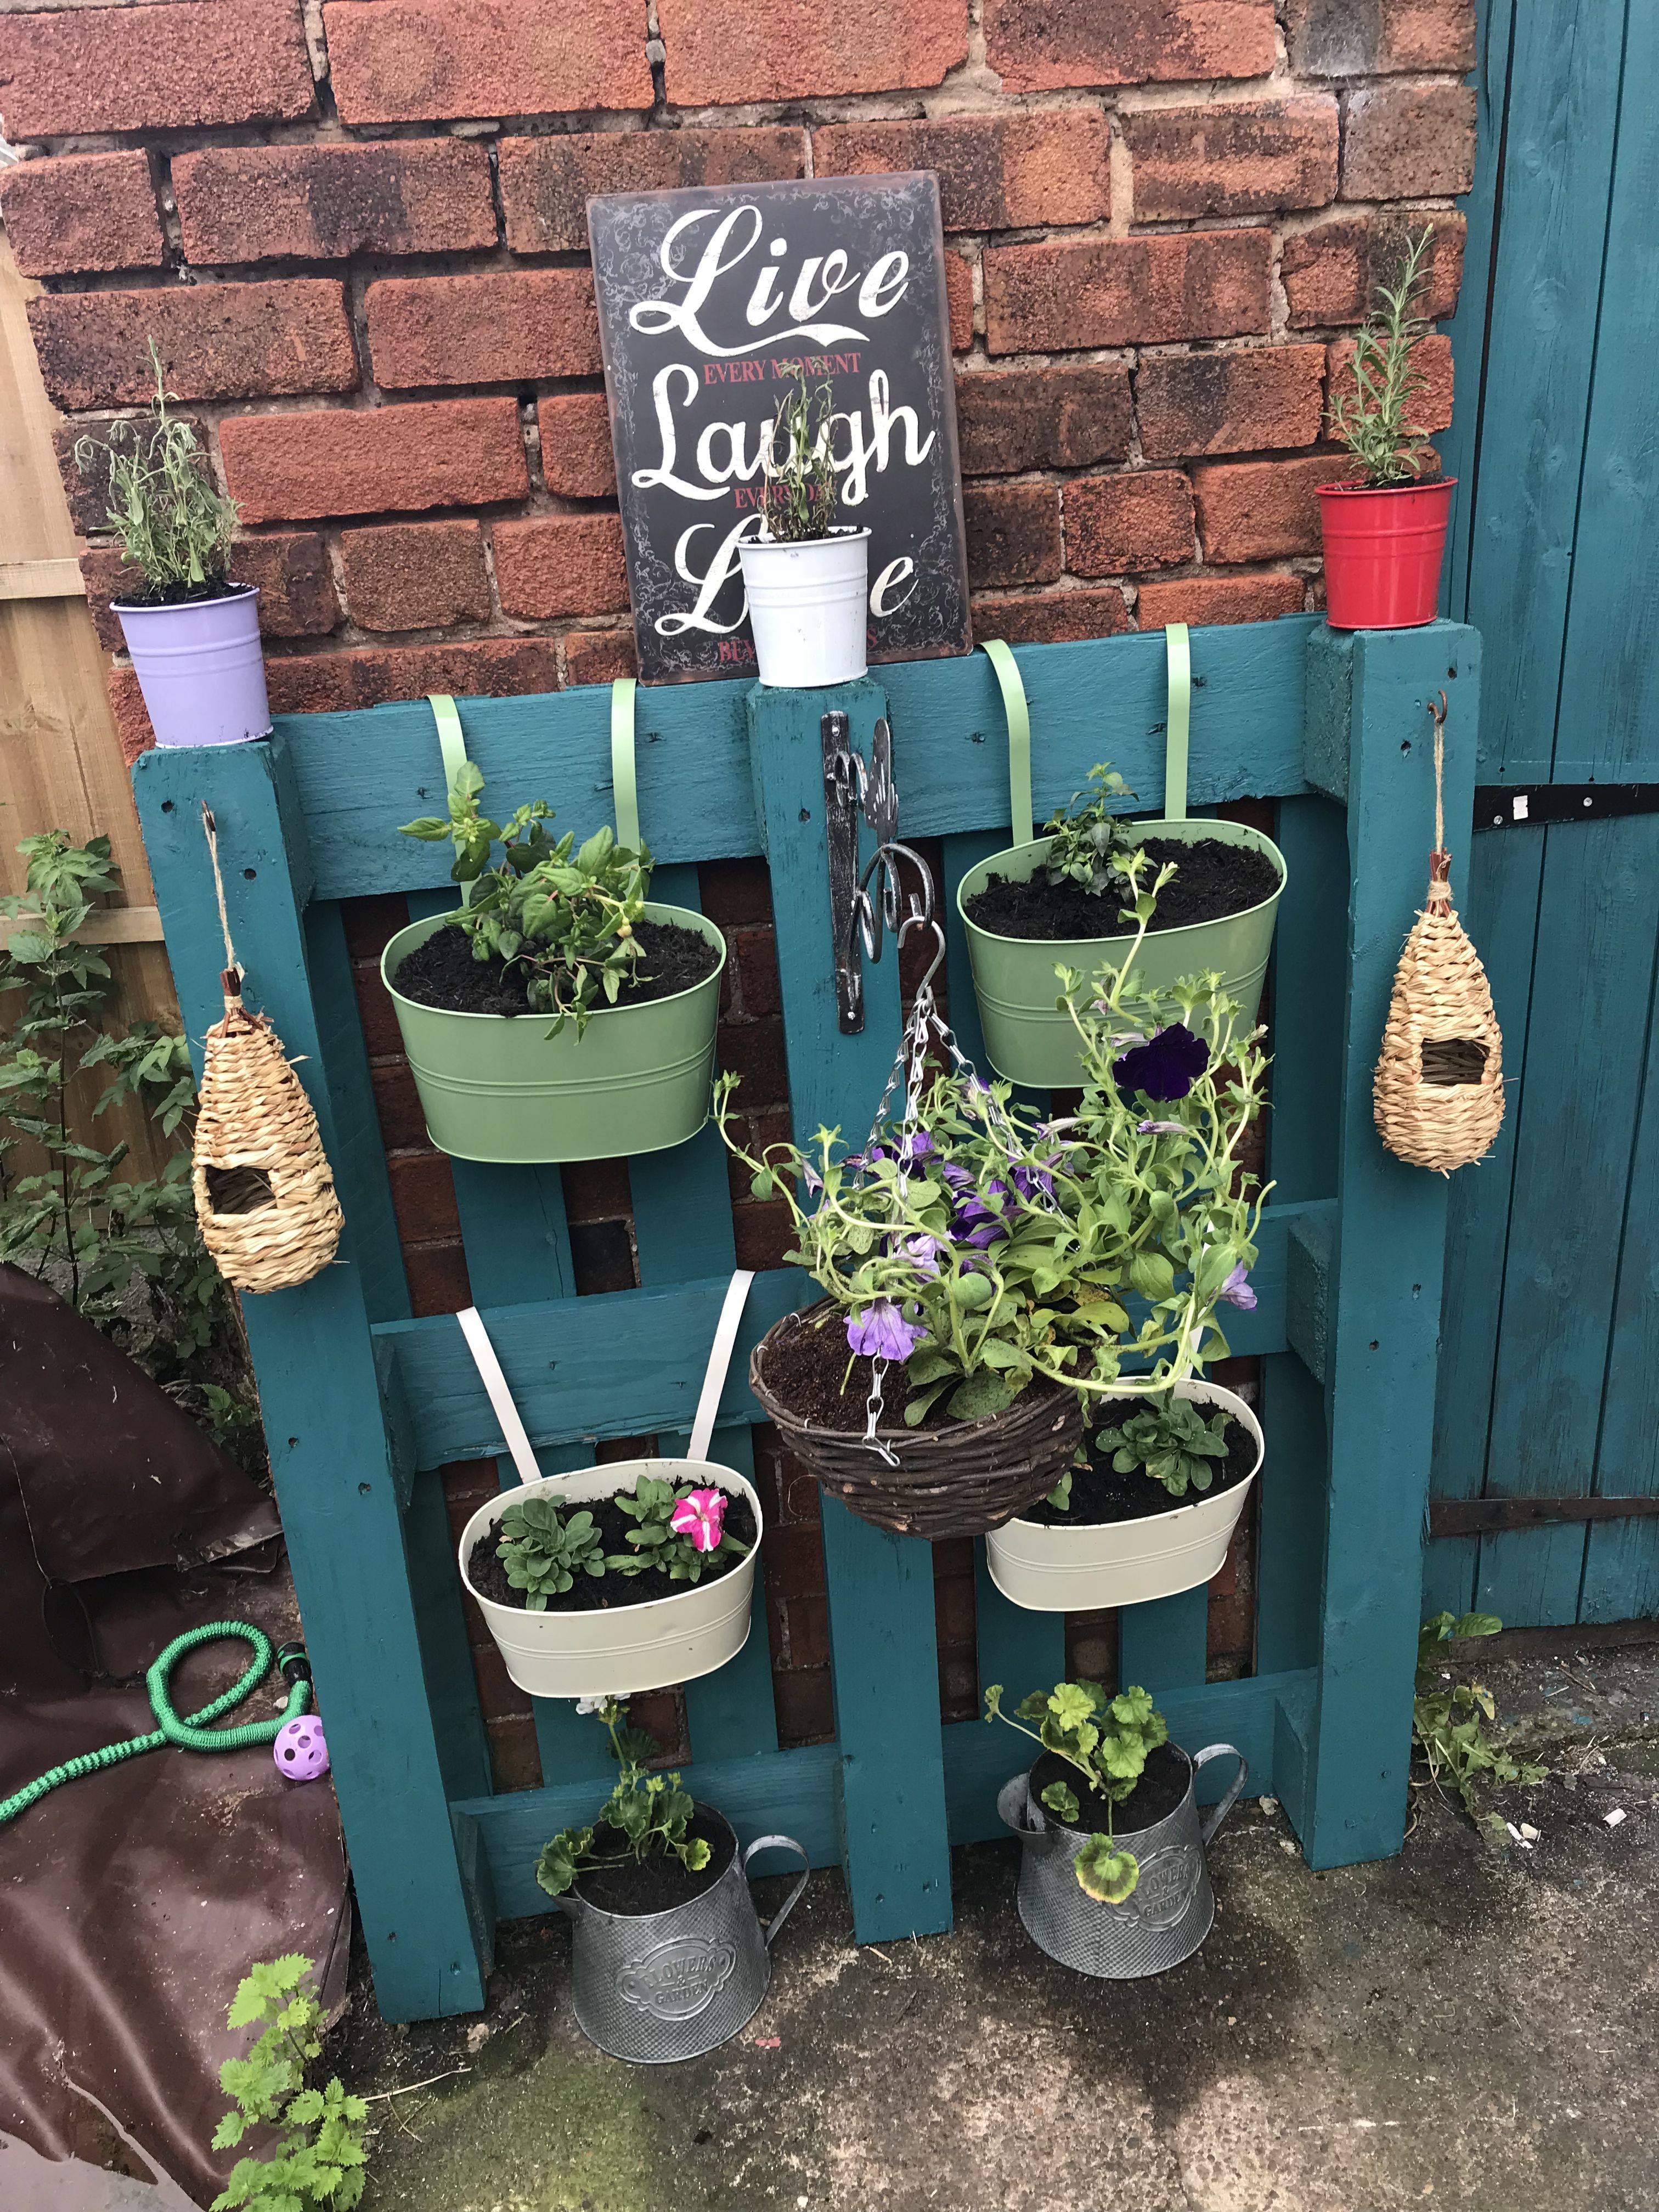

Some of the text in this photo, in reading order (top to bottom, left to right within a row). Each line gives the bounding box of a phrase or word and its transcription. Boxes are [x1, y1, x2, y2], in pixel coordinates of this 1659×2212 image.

[629, 205, 910, 357] Live
[703, 352, 861, 385] EVERY MOMENT
[631, 364, 936, 505] Laugh
[654, 514, 919, 635] Le
[639, 1955, 716, 1989] FLOWERS
[654, 1978, 708, 2004] GARDEN
